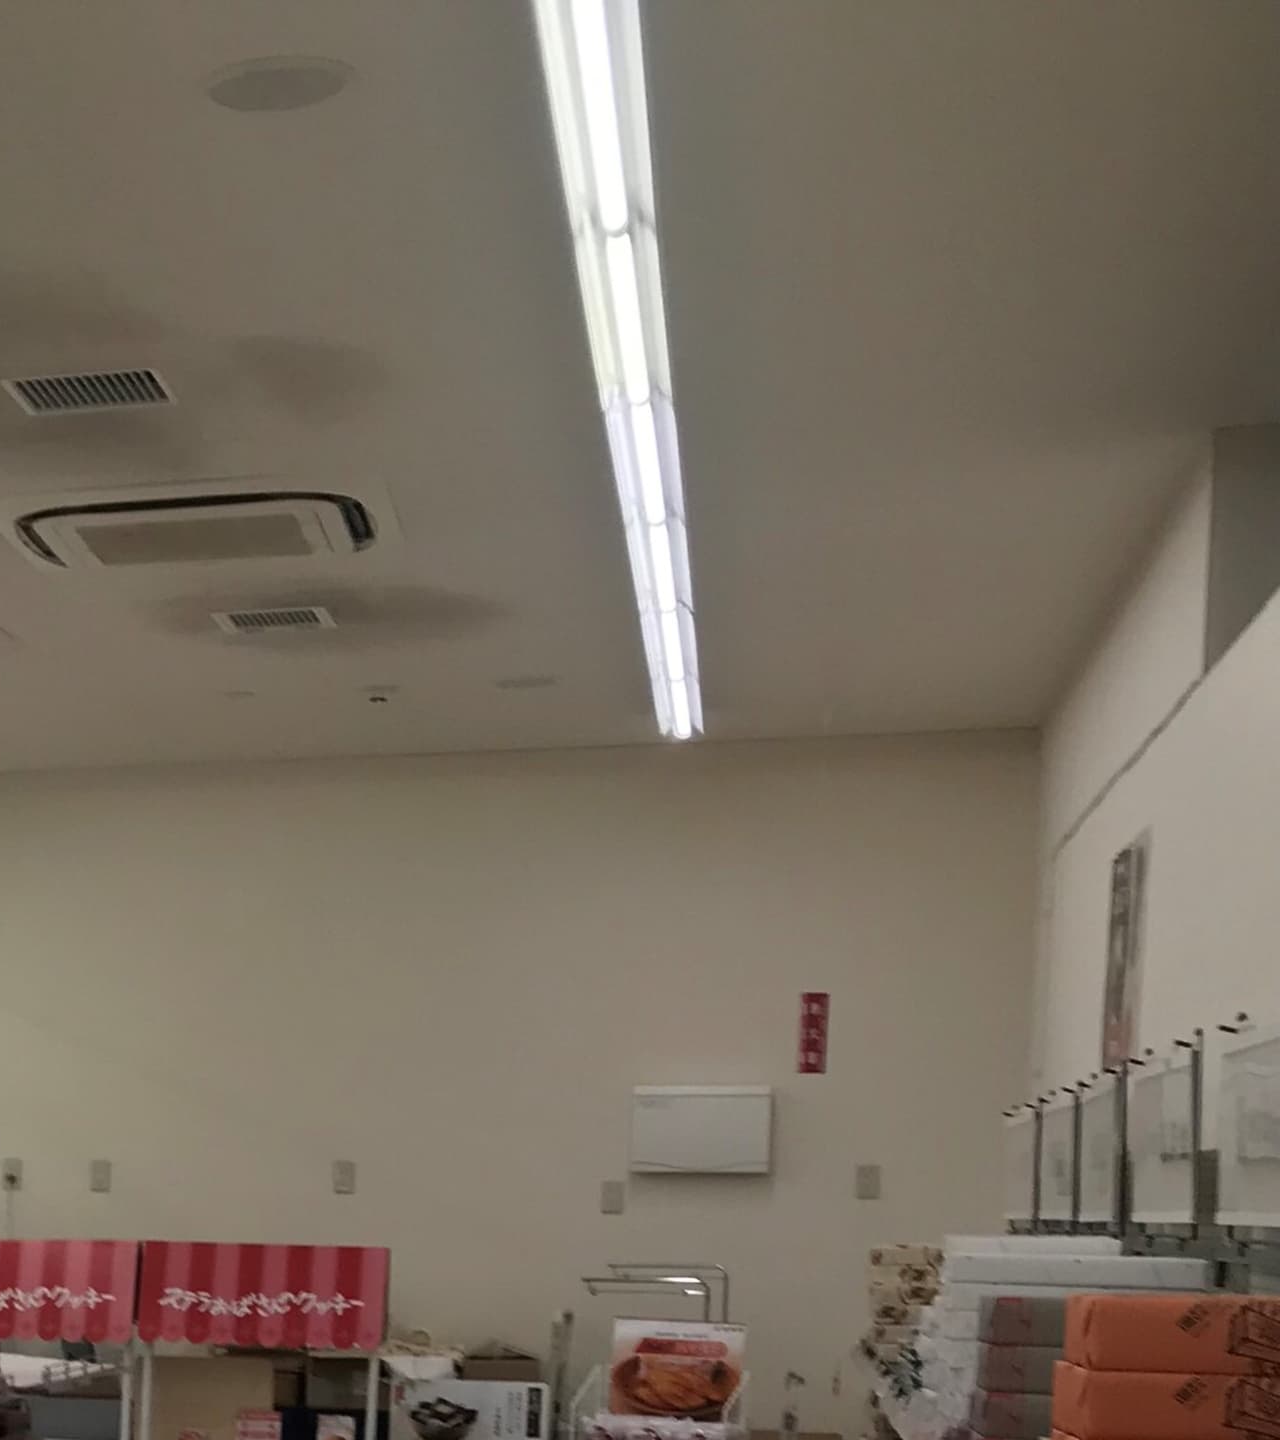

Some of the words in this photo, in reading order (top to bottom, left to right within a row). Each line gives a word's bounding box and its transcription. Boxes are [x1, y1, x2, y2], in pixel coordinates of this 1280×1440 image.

[158, 1287, 366, 1318] ステラおばさんのクッキー
